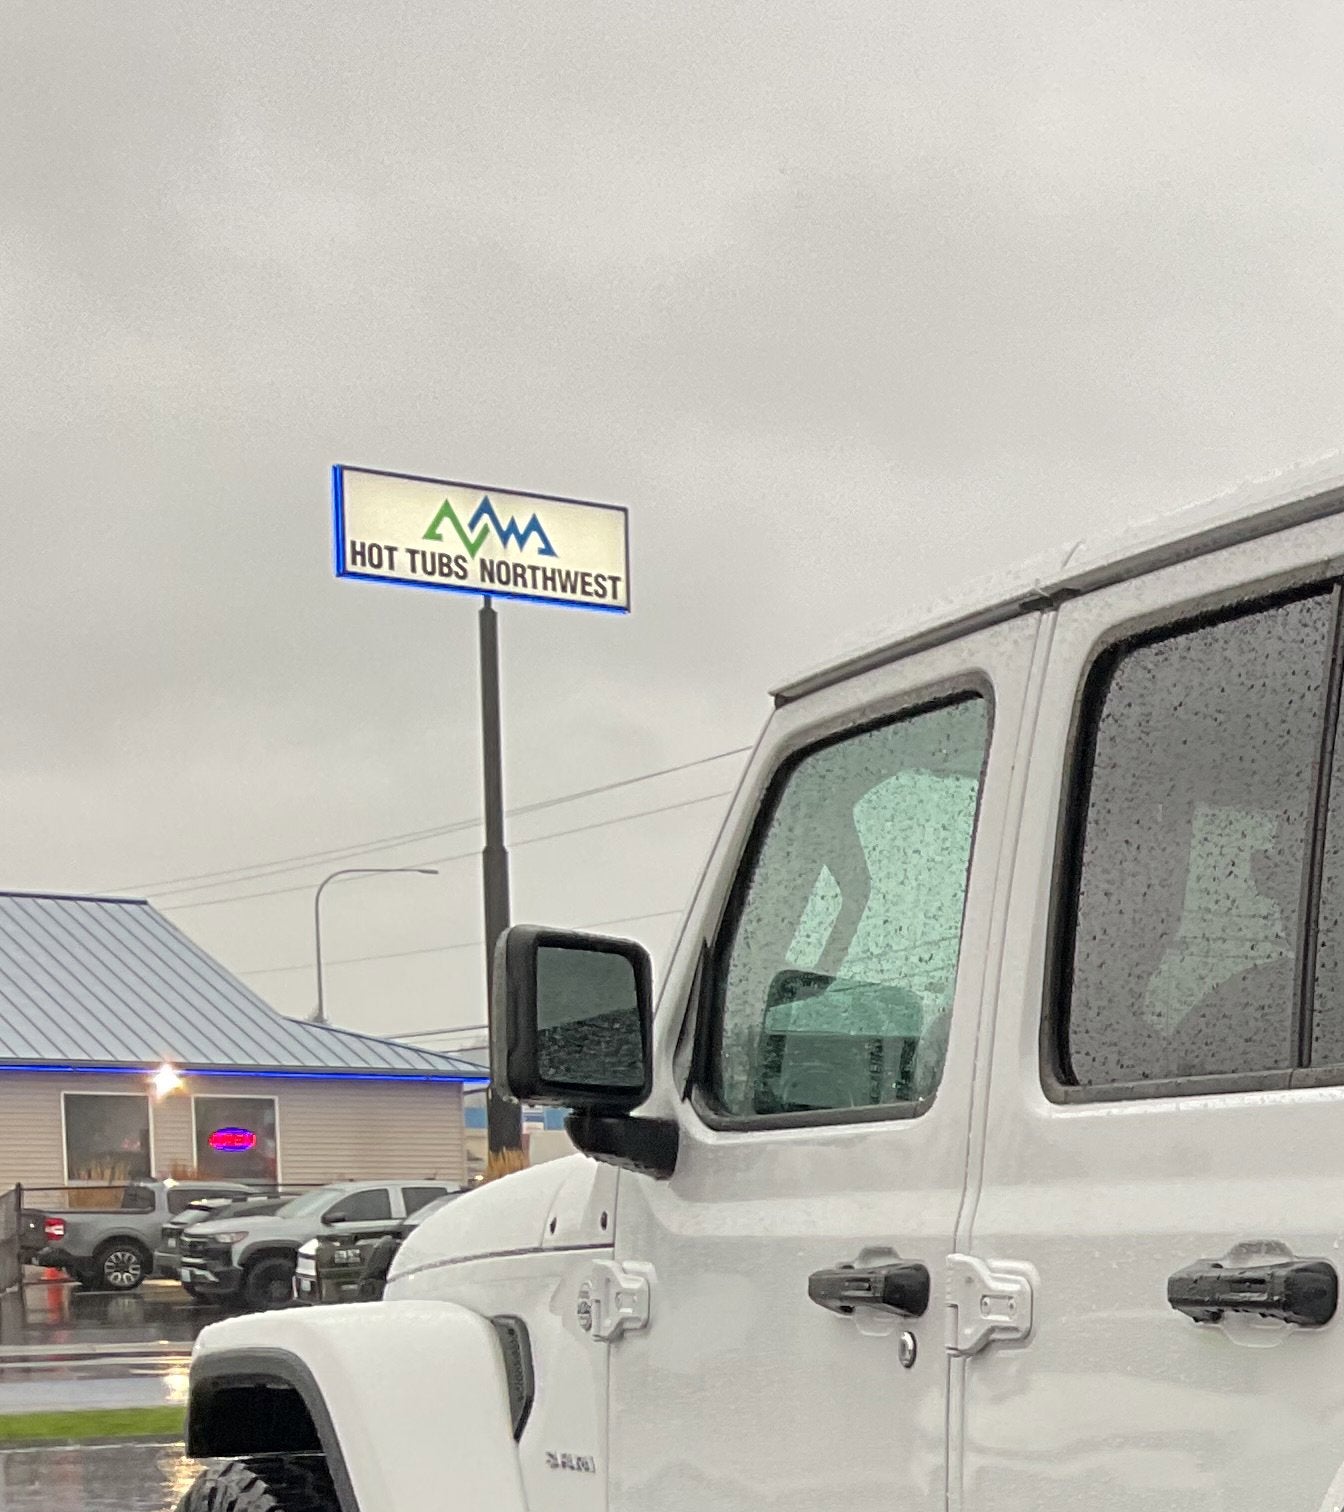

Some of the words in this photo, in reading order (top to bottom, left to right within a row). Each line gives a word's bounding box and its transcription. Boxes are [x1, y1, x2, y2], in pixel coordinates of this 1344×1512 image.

[350, 540, 399, 571] HOT
[406, 548, 468, 580] TUBS
[480, 558, 621, 600] NORTHWEST
